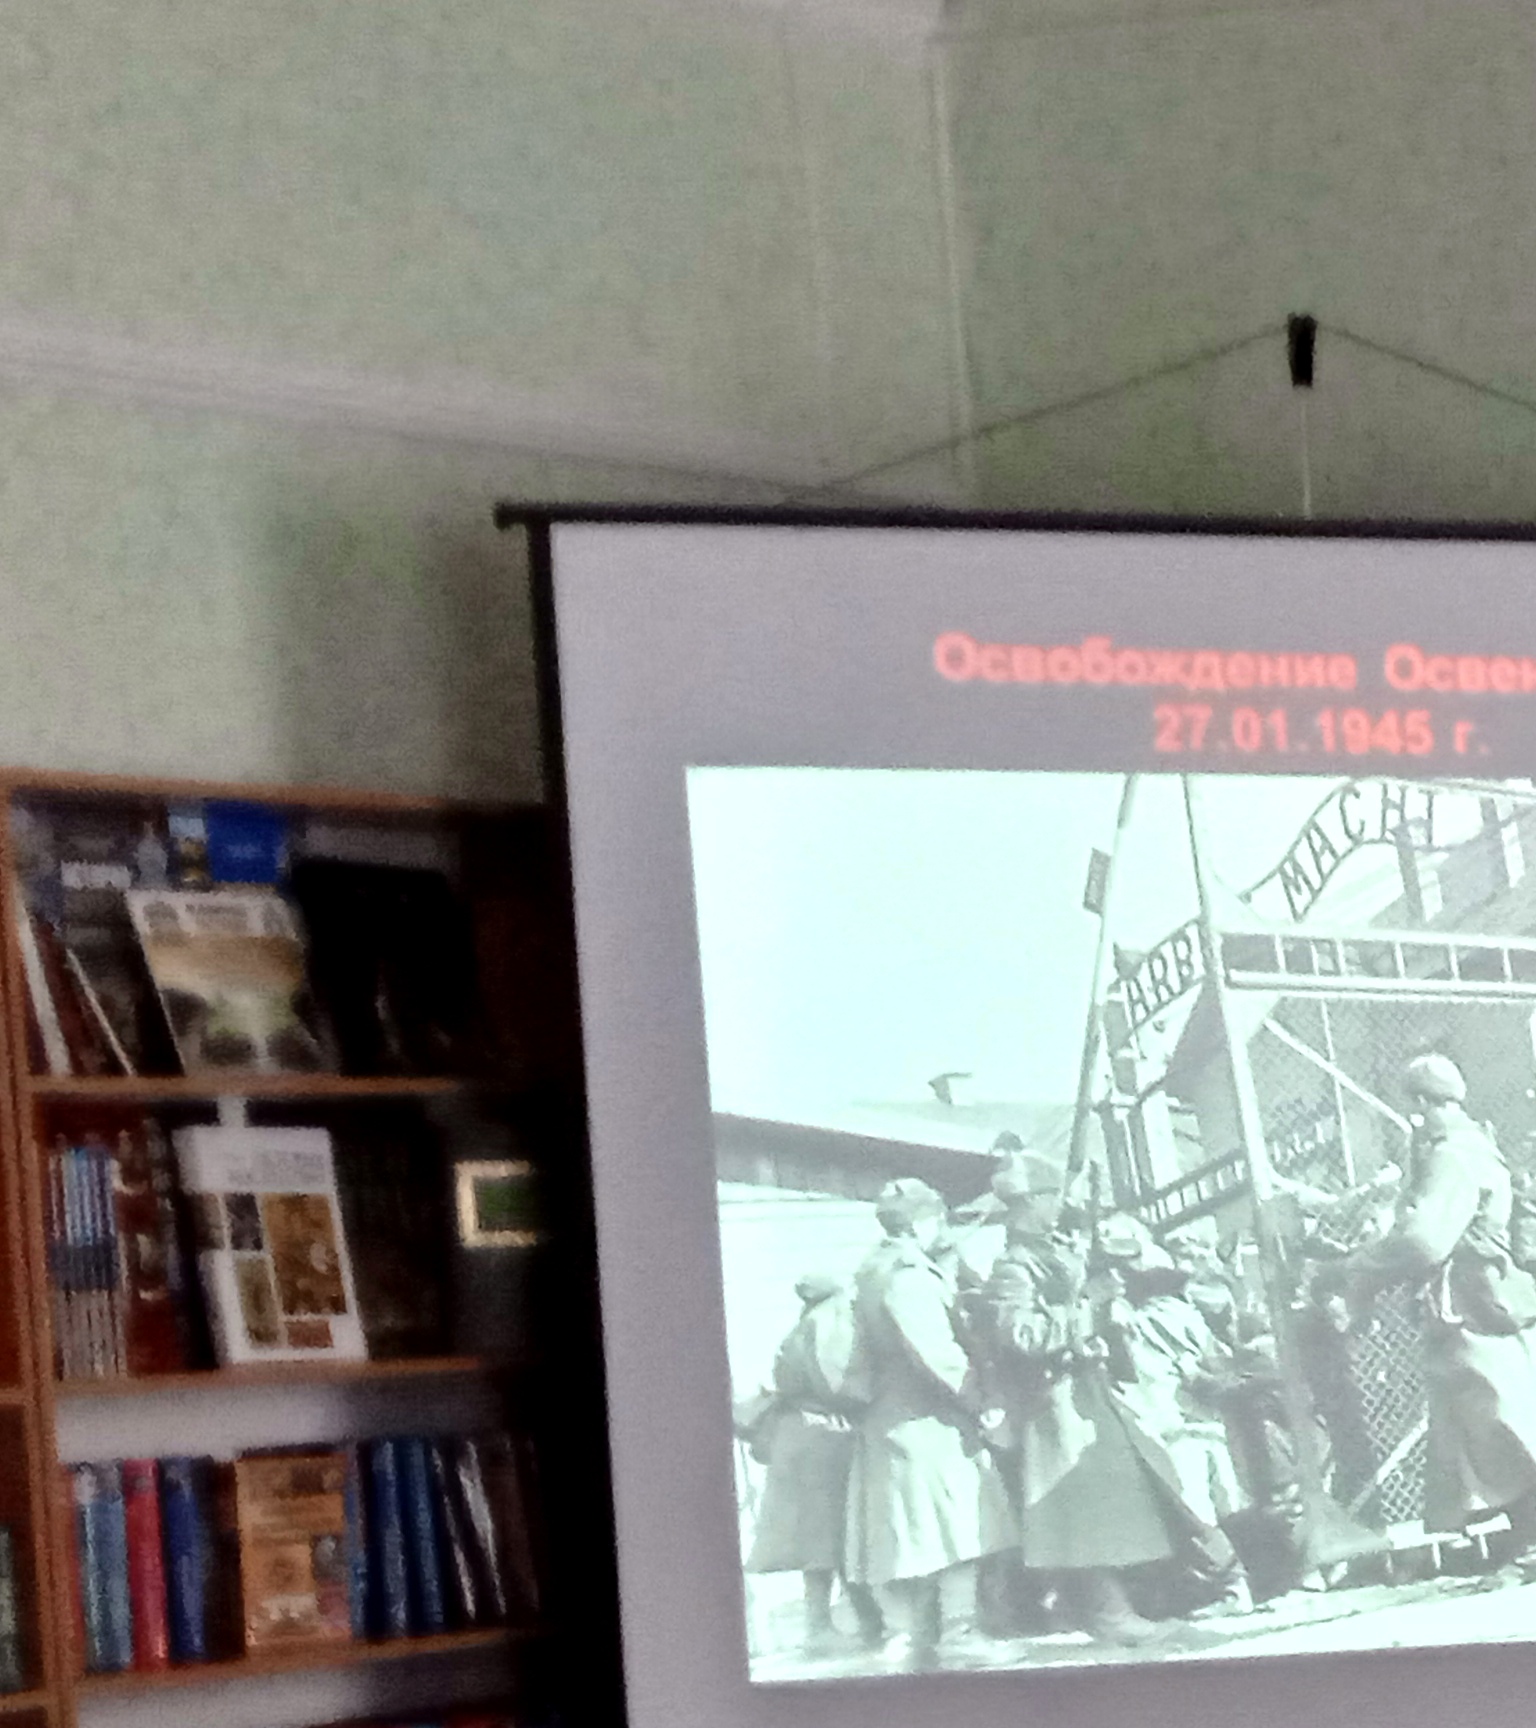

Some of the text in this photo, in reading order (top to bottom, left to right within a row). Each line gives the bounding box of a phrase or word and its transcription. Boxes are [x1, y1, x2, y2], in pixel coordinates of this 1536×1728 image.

[933, 630, 1358, 692] Освобождение
[1152, 704, 1490, 756] 27.01.1945 г.
